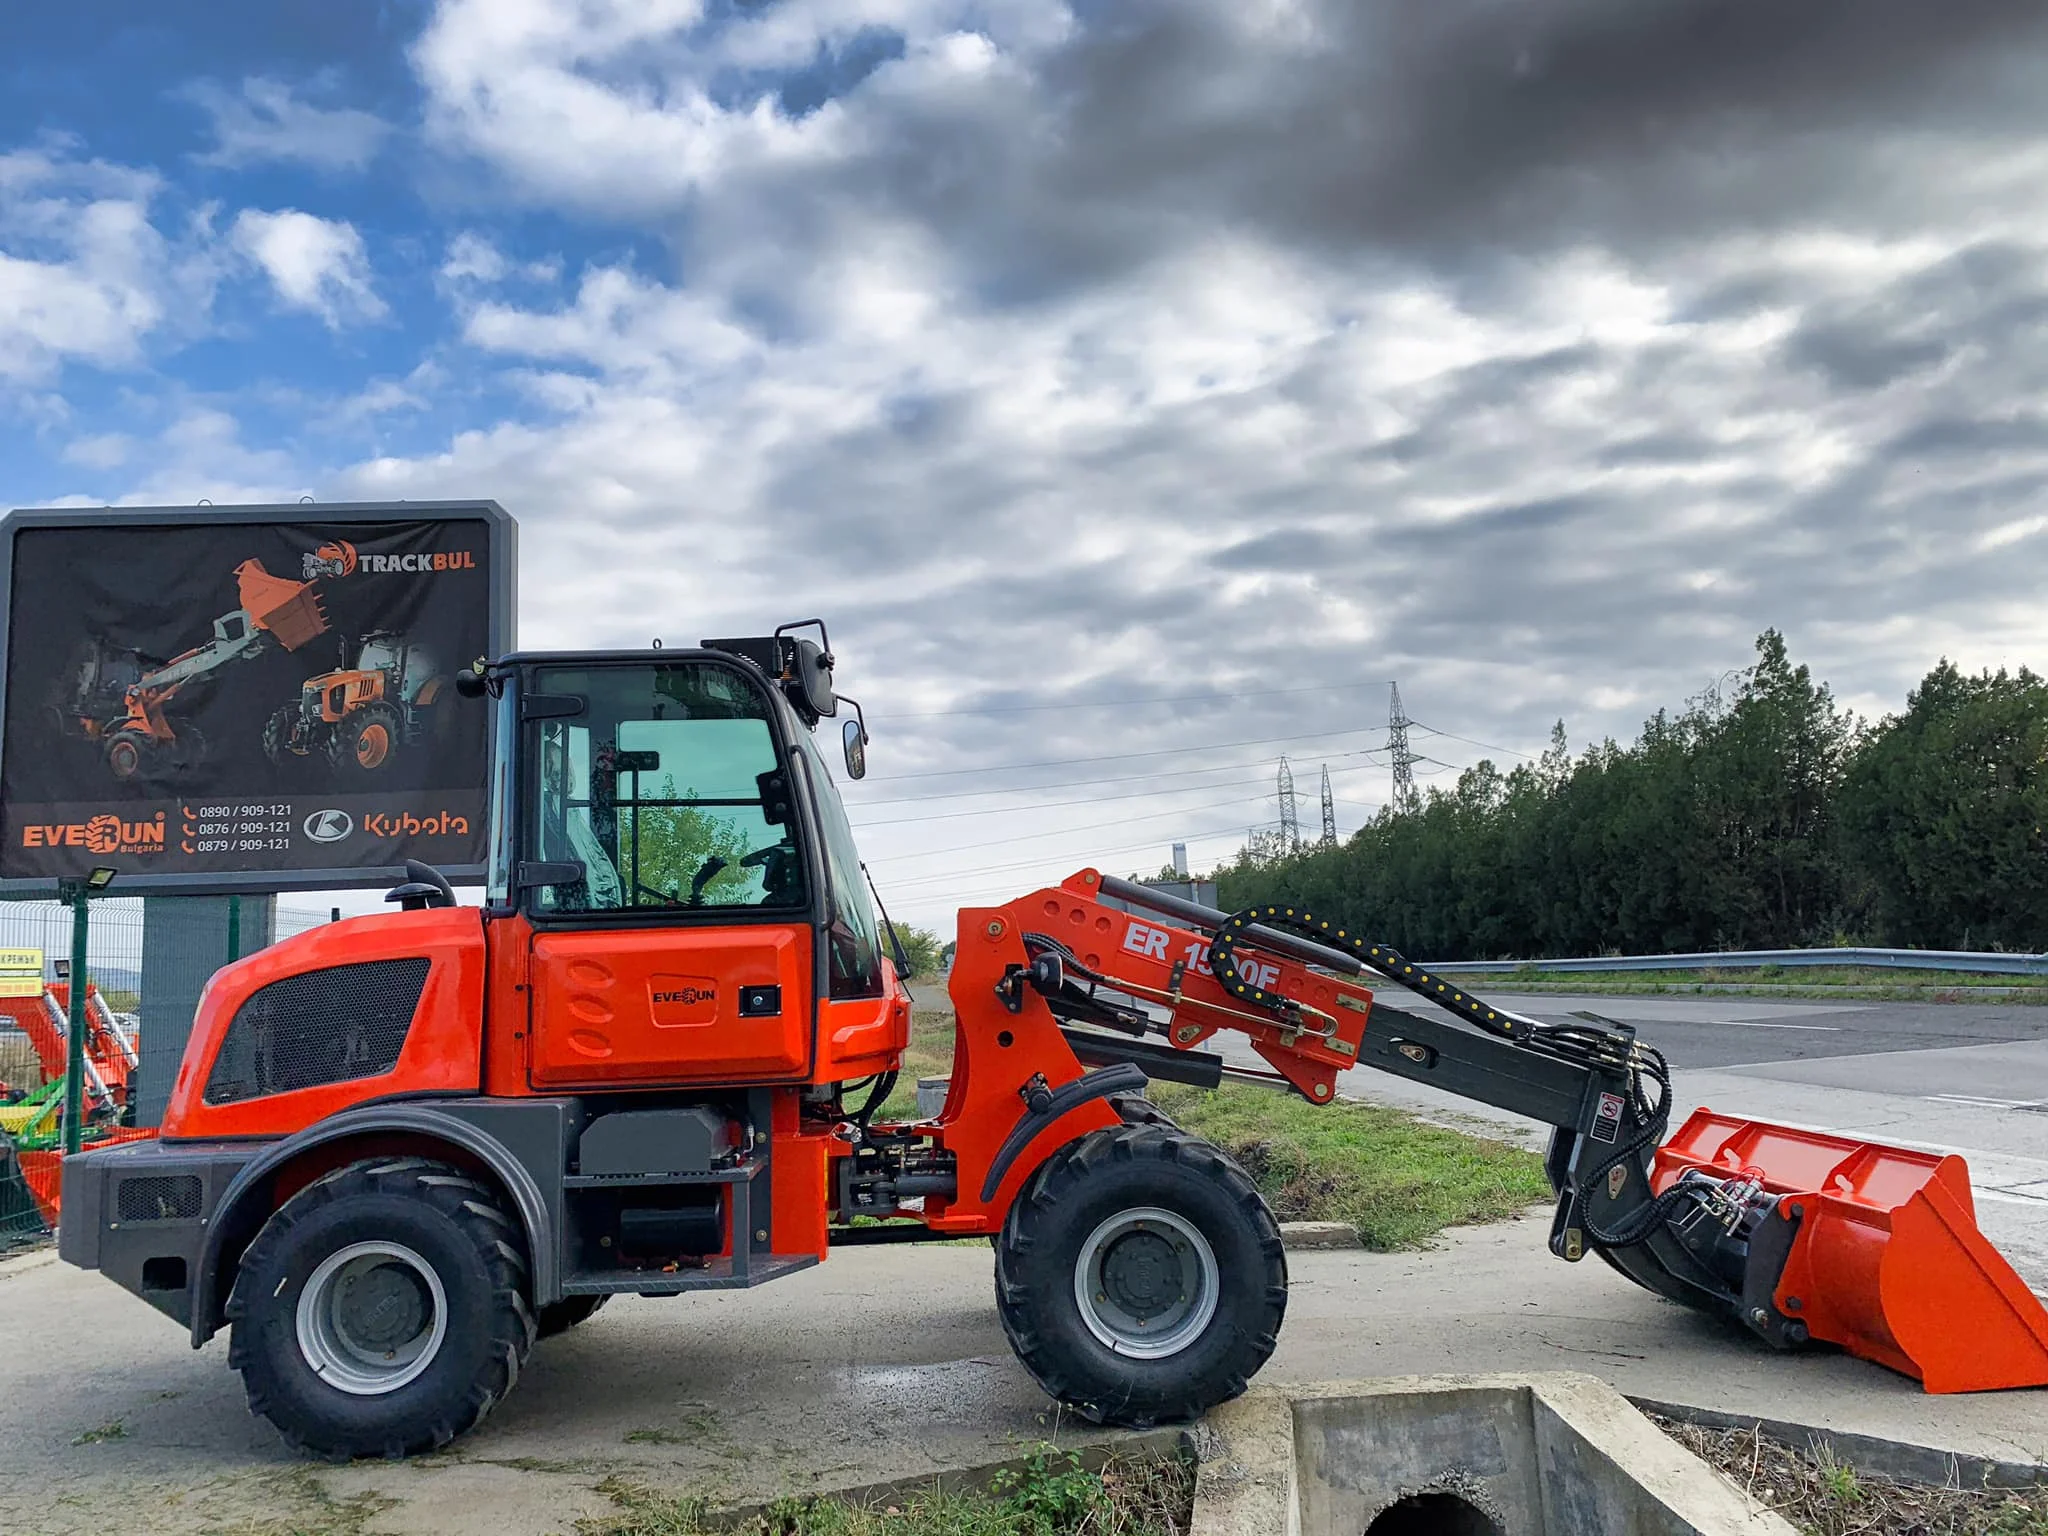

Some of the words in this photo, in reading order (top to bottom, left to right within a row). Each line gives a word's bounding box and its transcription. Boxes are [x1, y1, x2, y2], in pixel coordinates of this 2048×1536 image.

[359, 552, 476, 572] TRACKBUL
[200, 806, 230, 818] 0890
[232, 806, 239, 817] /
[241, 804, 291, 817] 909-121
[199, 823, 229, 835] 0876
[231, 823, 238, 834] /
[240, 821, 290, 834] 909-121
[364, 810, 469, 837] Kubota
[23, 814, 165, 854] EVERUN
[120, 844, 164, 854] Bulgaria
[198, 840, 228, 852] 0879
[230, 840, 237, 851] /
[239, 838, 289, 851] 909-121
[1123, 922, 1170, 960] ER
[1184, 942, 1280, 990] 150F
[653, 987, 715, 1005] EVERUN
